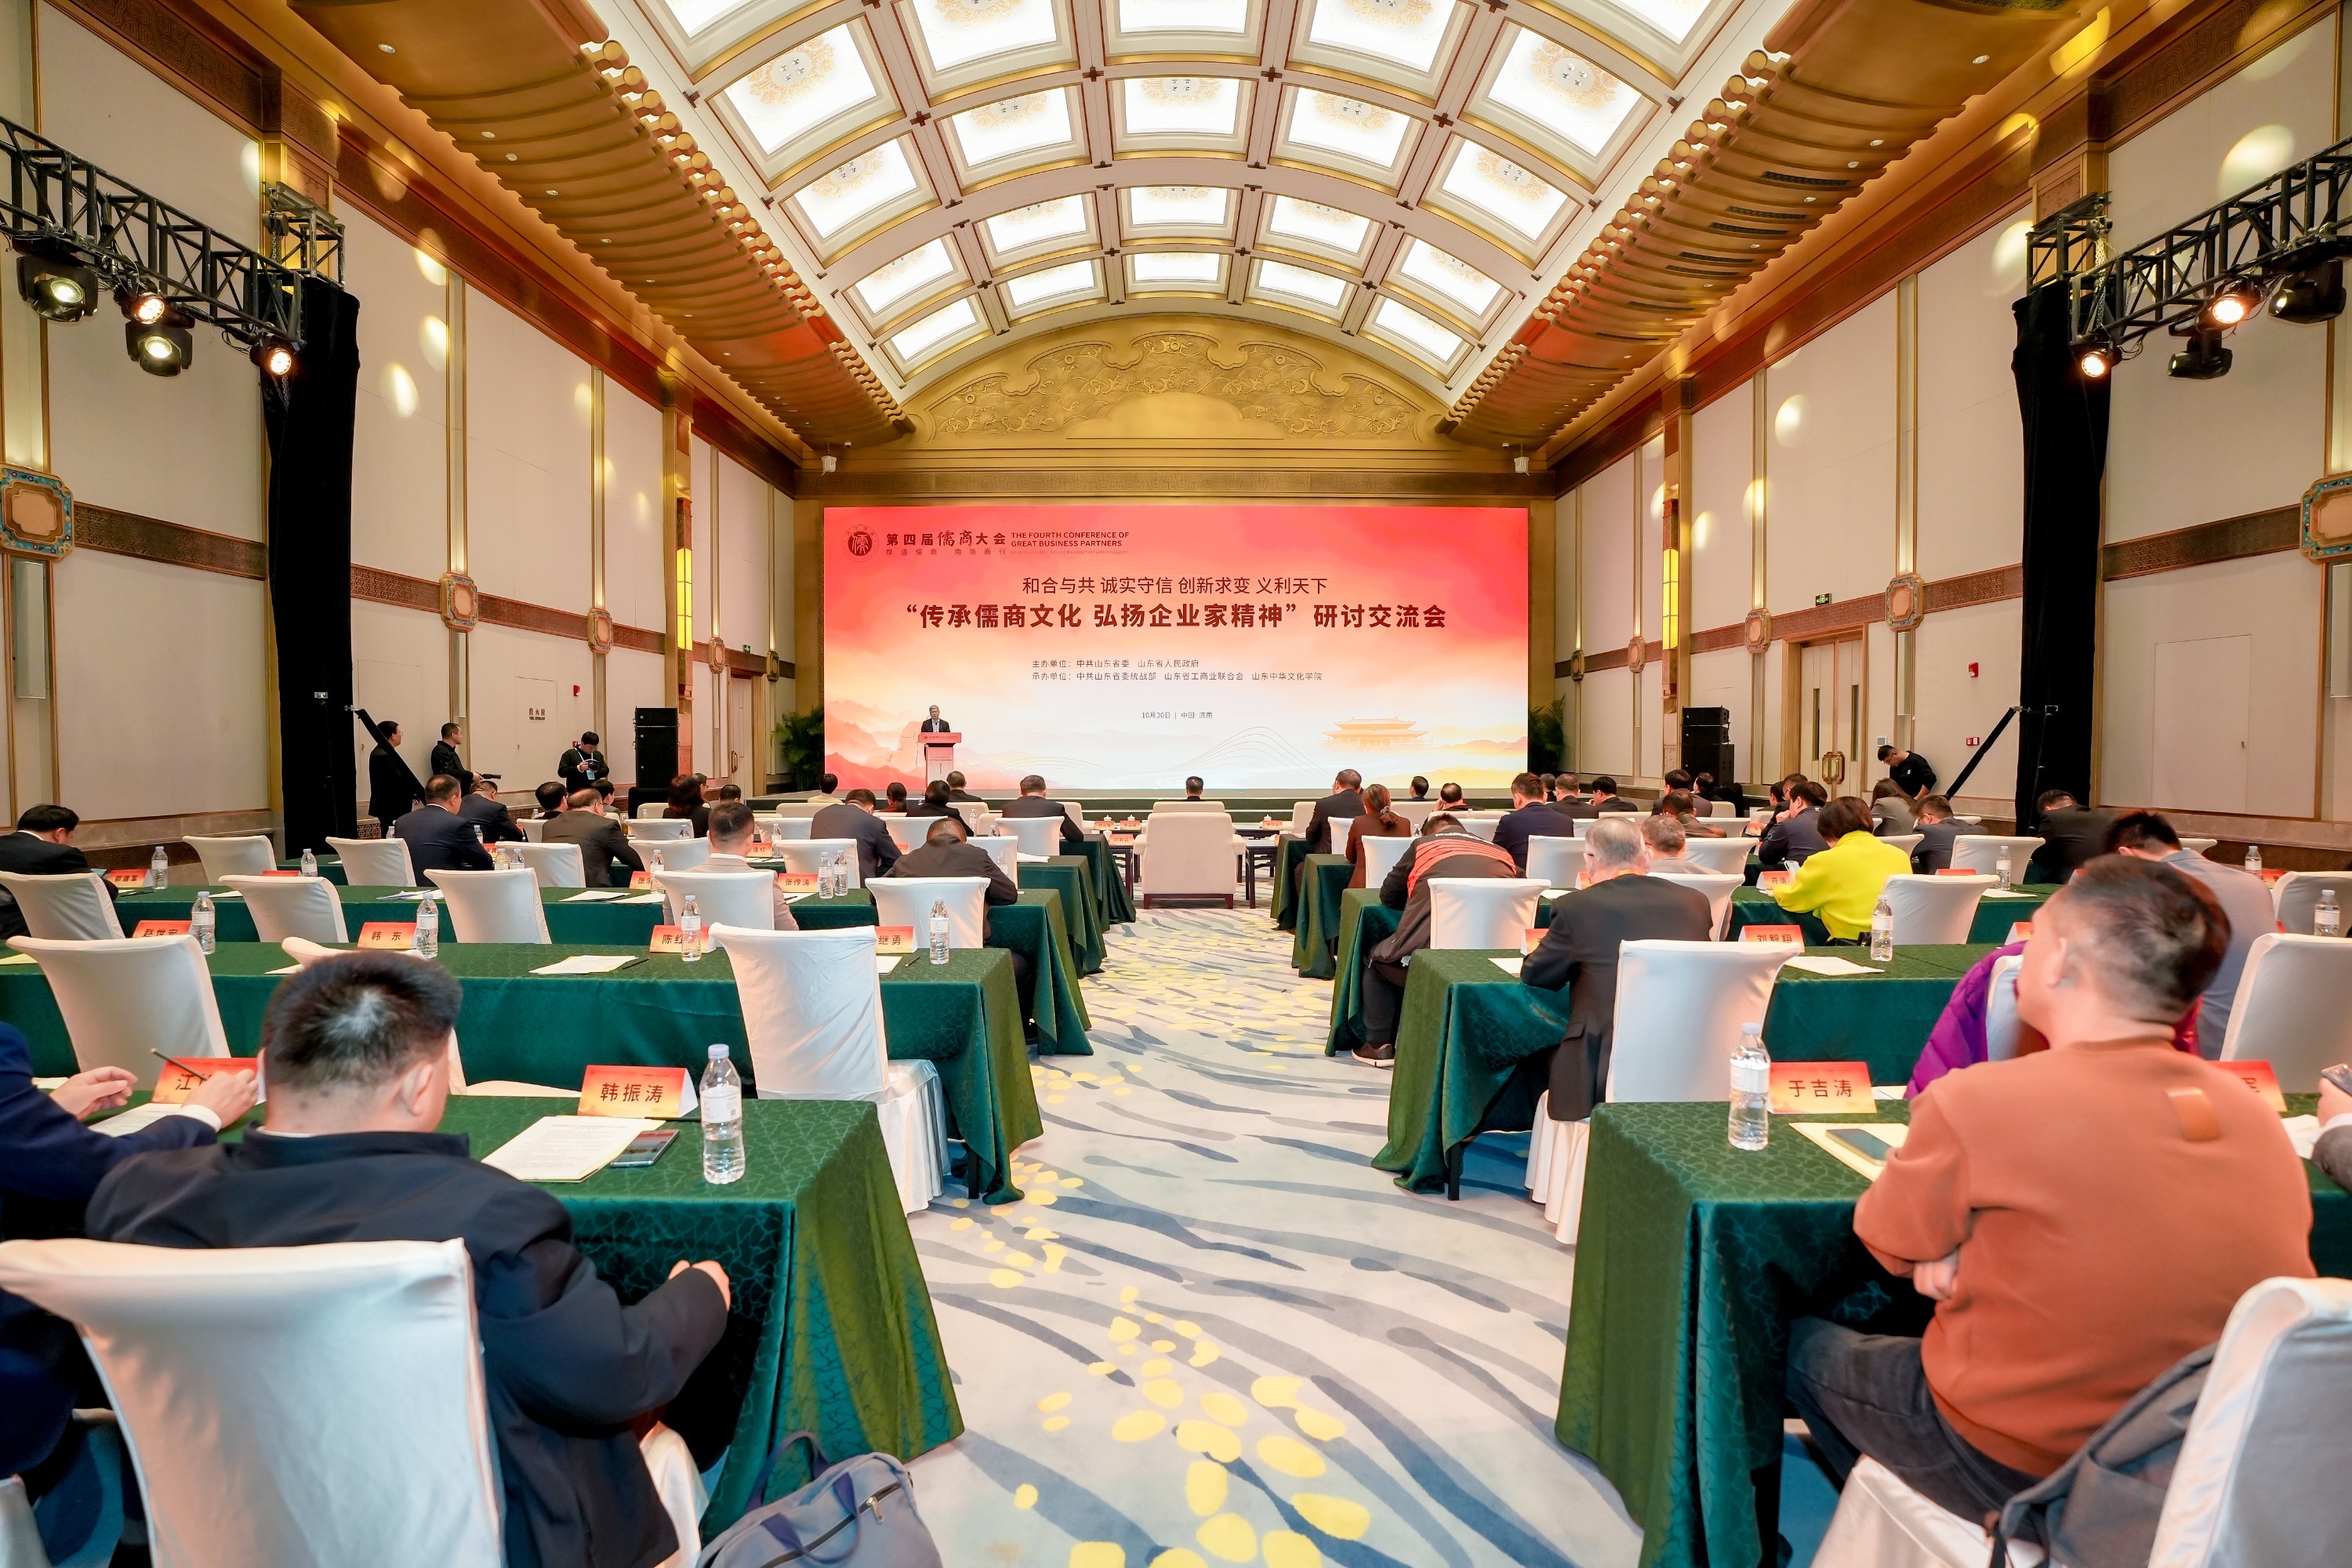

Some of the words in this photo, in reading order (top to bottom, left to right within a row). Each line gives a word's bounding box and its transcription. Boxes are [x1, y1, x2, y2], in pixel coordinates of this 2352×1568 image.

[886, 529, 1006, 547] 第四届儒商大会
[1022, 576, 1095, 594] 和合与共
[1100, 576, 1173, 594] 诚实守信
[1178, 576, 1250, 594] 创新求变
[1255, 576, 1328, 594] 义利天下
[906, 602, 1082, 628] “传承儒商文化
[1138, 659, 1200, 668] 山东省人民政府
[1164, 672, 1244, 681] 山东省工商业联合会
[1251, 672, 1323, 681] 山东中华文化学院
[1435, 831, 1494, 846] PORSC
[878, 935, 901, 946] 继勇
[600, 1082, 664, 1103] 韩振涛
[1788, 1079, 1853, 1098] 于吉涛
